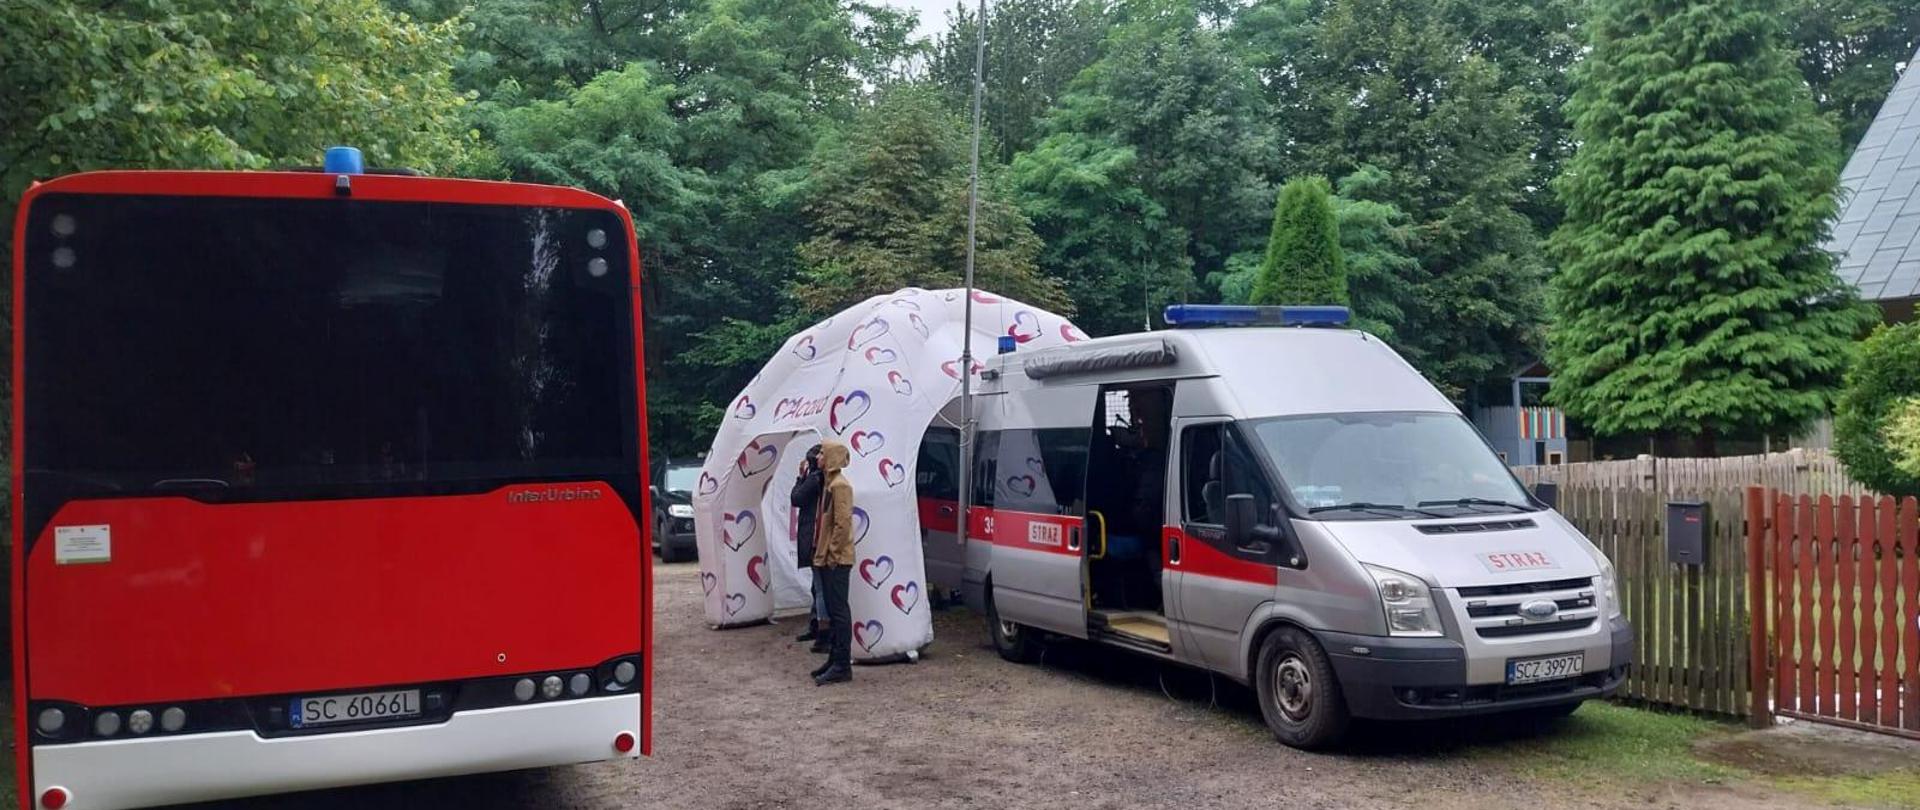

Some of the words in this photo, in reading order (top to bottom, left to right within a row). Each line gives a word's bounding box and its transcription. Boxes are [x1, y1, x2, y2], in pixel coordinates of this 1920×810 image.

[508, 487, 602, 503] InterUrbino
[1516, 661, 1541, 679] SCZ
[1544, 656, 1582, 676] 3997C
[305, 699, 337, 721] SC
[346, 692, 416, 718] 6066L
